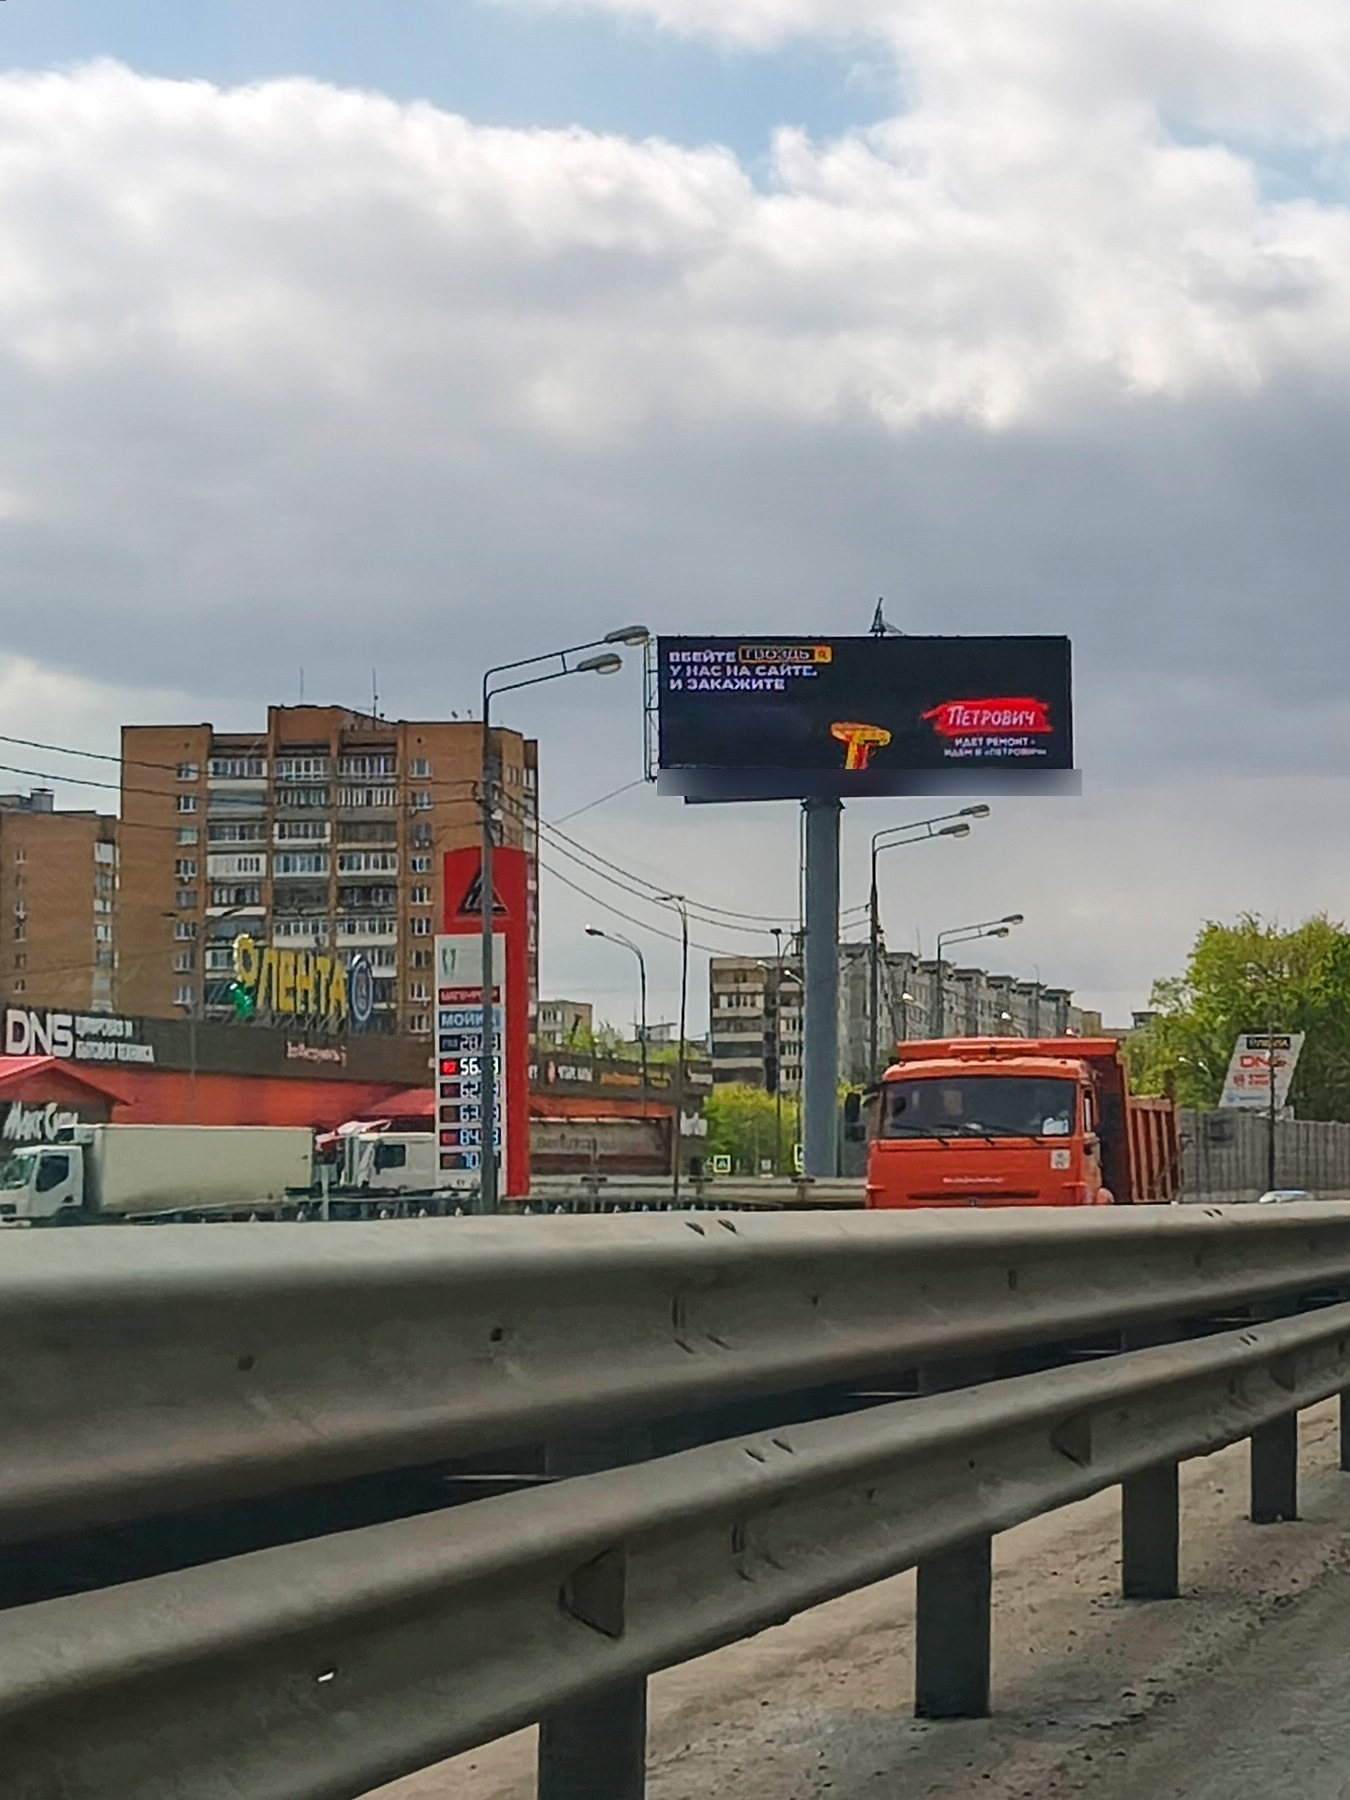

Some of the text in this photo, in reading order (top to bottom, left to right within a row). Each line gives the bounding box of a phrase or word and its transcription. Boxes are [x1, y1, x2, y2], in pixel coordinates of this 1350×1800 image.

[669, 665, 682, 676] У
[686, 665, 722, 676] НАС
[726, 665, 750, 676] НА
[669, 678, 785, 690] И ЗАКАЖИТЕ
[256, 948, 347, 1018] ЛЕНТА
[5, 1009, 74, 1058] DNS
